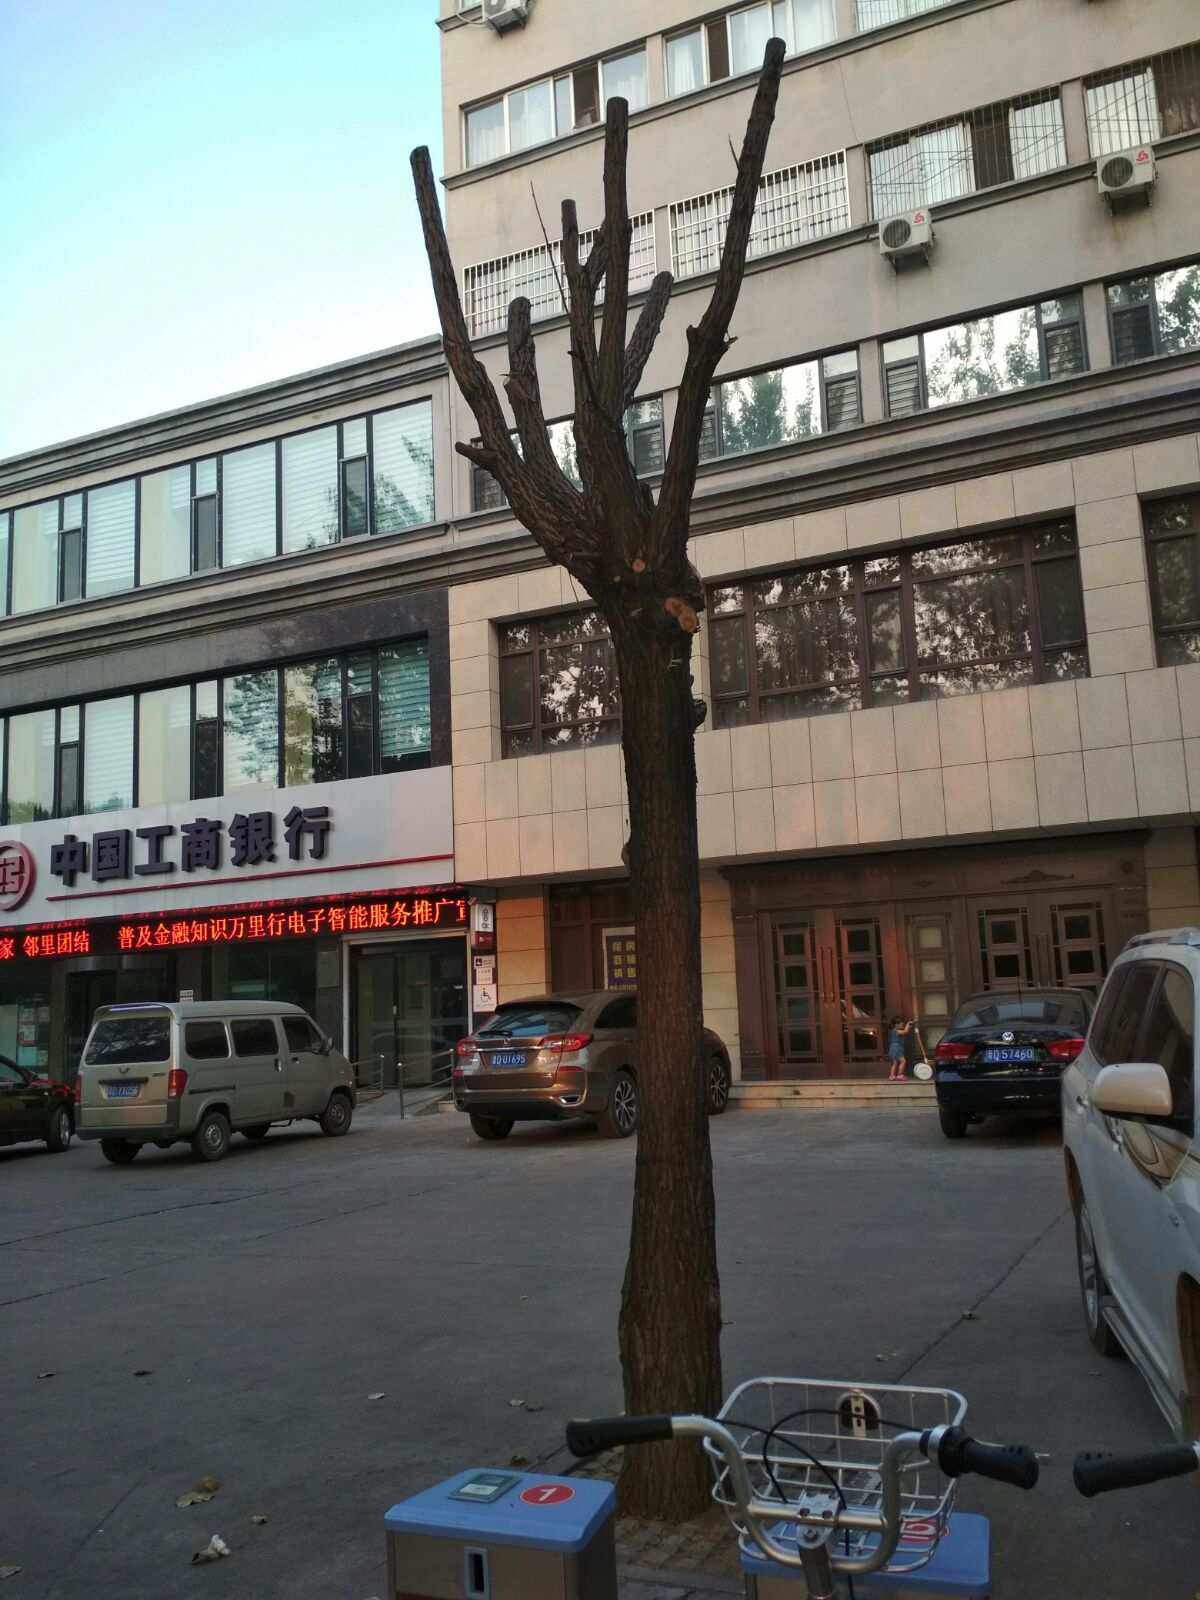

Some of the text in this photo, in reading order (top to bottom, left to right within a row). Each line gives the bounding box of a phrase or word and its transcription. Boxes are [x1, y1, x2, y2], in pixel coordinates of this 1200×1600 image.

[50, 806, 331, 887] 中国工商银行
[23, 930, 90, 957] 邻里团结
[539, 1487, 558, 1502] 1
